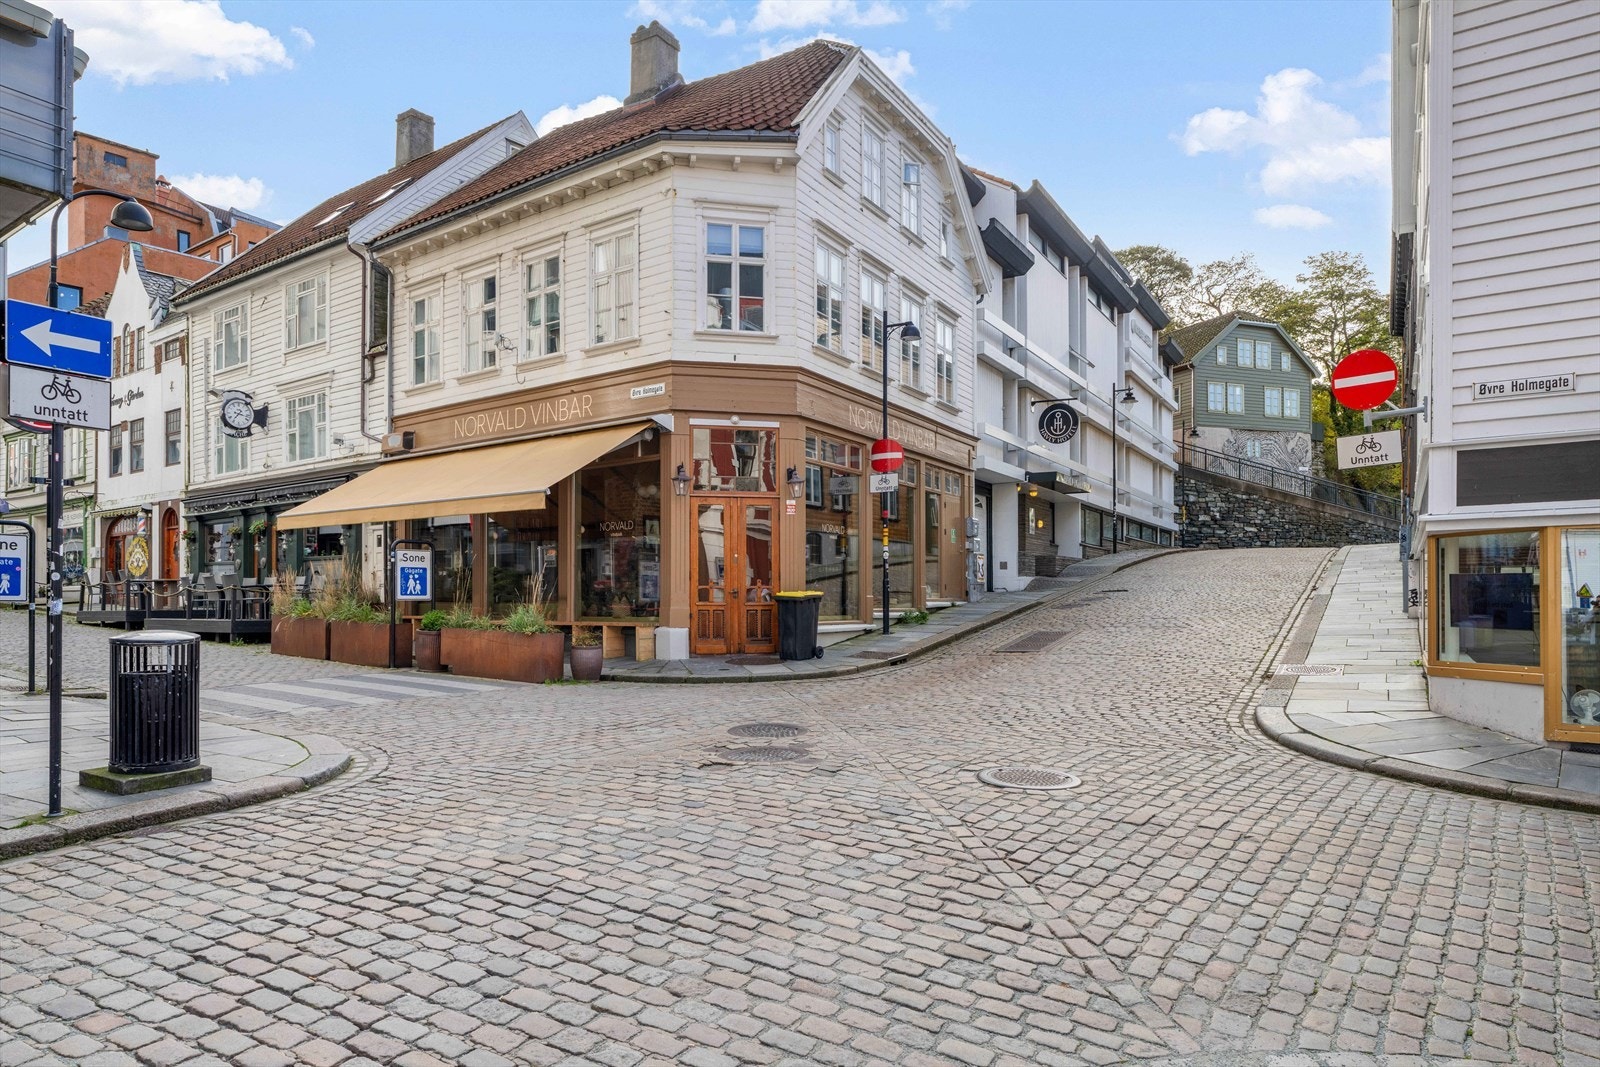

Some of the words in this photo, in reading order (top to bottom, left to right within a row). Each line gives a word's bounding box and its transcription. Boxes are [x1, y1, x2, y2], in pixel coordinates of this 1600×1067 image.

[1479, 384, 1505, 395] Øvre
[1511, 376, 1569, 391] Holmegate
[34, 405, 88, 422] unntatt
[454, 407, 527, 439] NORVALD
[531, 394, 593, 425] VINBAR
[1350, 453, 1389, 465] Unntatt
[599, 520, 634, 531] NORVALD
[821, 523, 845, 534] NORVALD
[402, 552, 426, 562] Sone
